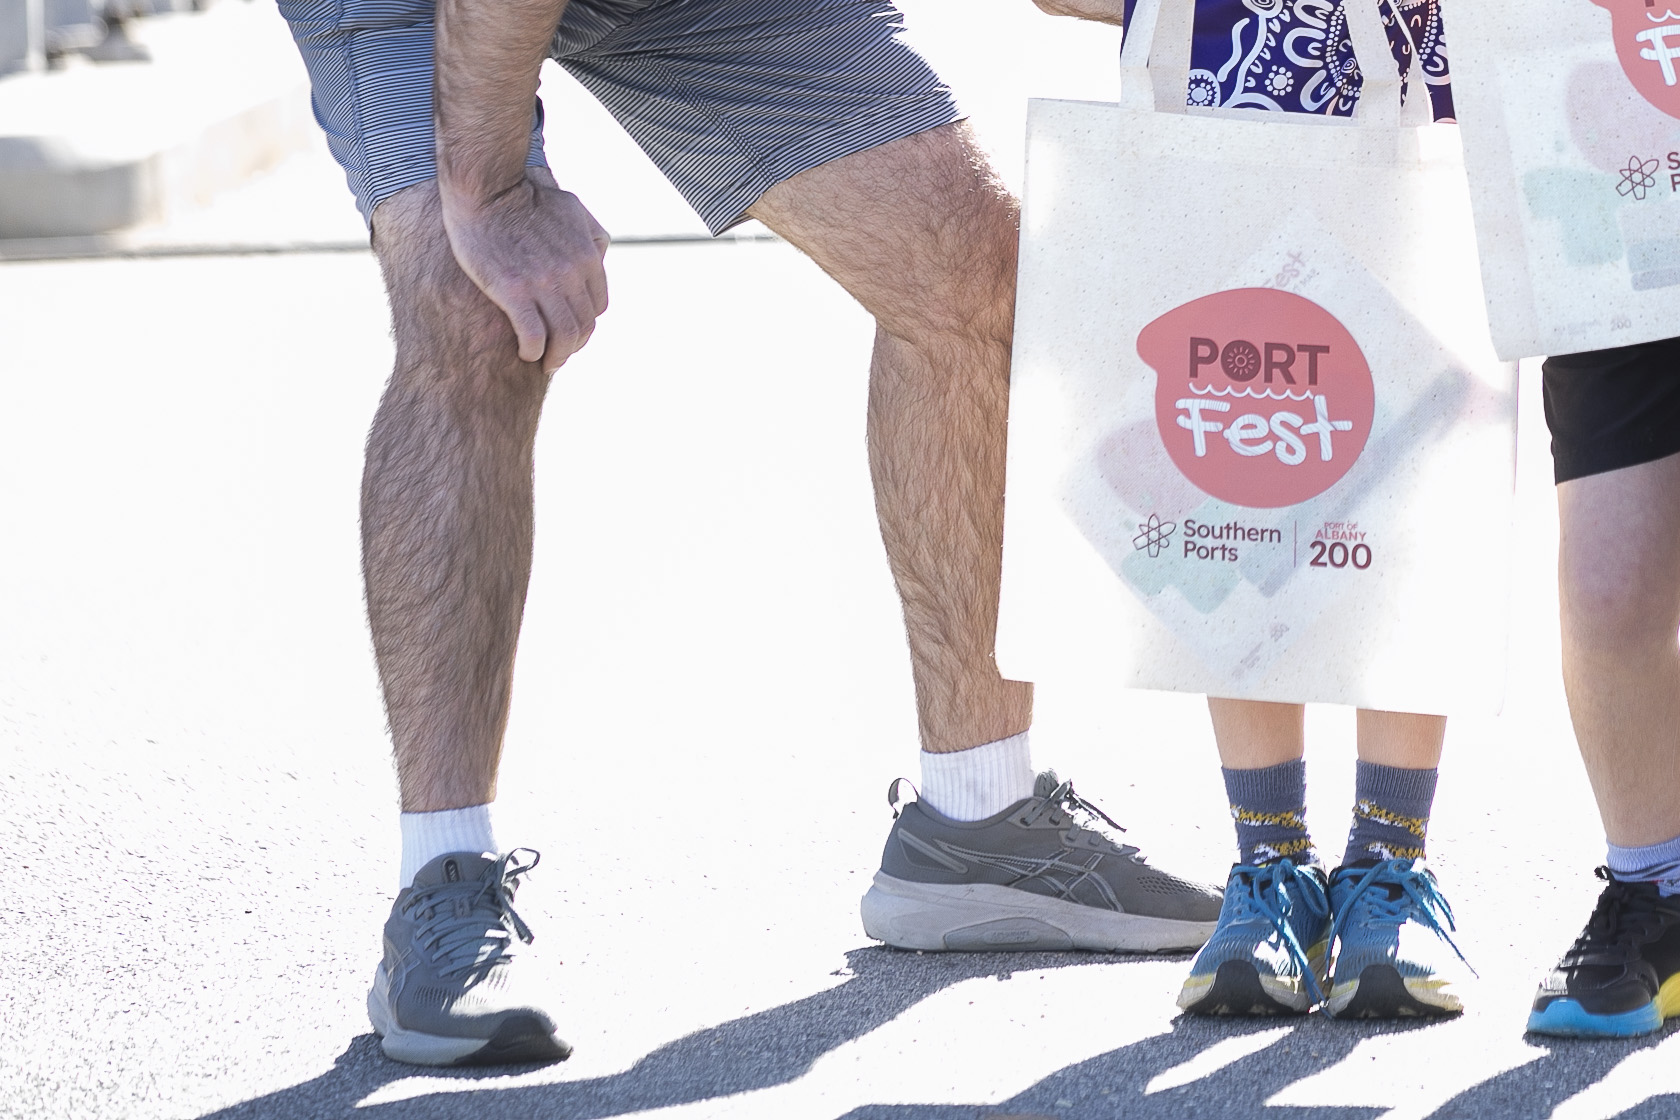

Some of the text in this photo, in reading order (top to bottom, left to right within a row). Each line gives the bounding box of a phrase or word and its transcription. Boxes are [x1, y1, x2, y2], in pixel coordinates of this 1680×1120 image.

[1188, 336, 1331, 386] PORT
[1175, 394, 1353, 466] Fest
[1183, 519, 1282, 543] Southern
[1315, 529, 1367, 541] ALBANY
[1324, 521, 1358, 530] PORT OF
[1183, 540, 1239, 562] Ports
[1309, 540, 1372, 570] 200
